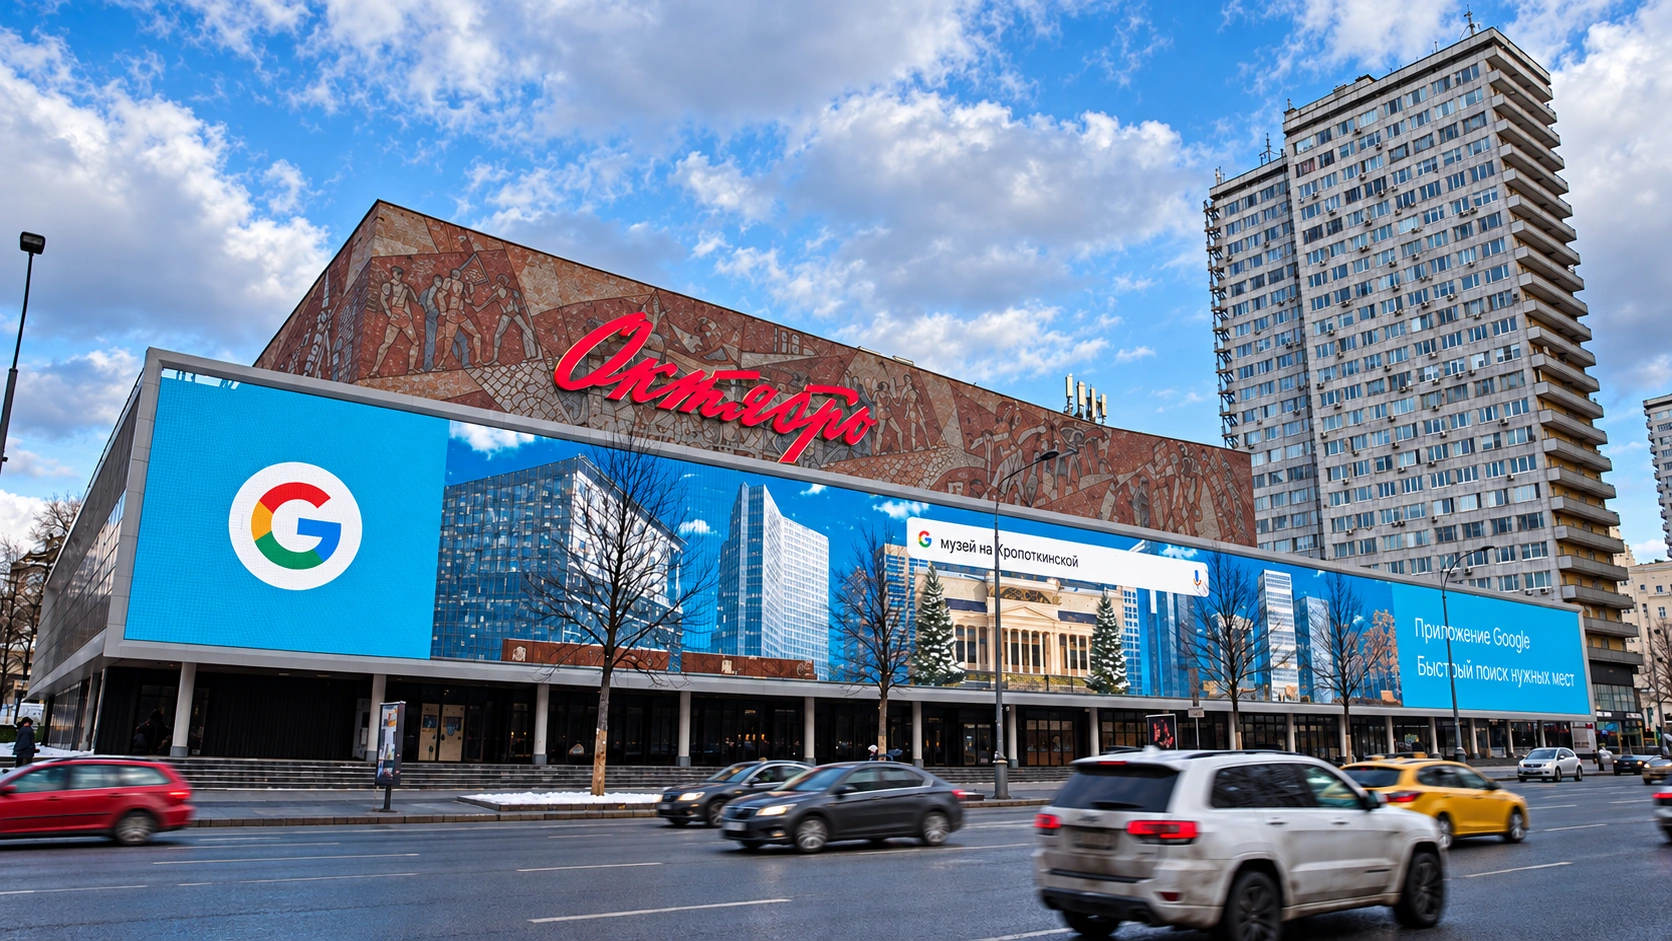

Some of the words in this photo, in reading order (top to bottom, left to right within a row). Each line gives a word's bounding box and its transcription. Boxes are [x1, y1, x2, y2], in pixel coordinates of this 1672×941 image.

[251, 482, 342, 570] G
[918, 530, 932, 548] G
[940, 538, 976, 554] музей
[979, 544, 993, 556] на
[1414, 617, 1491, 645] Приложение
[1493, 627, 1531, 654] Google
[1476, 664, 1509, 682] поиск
[1511, 668, 1551, 688] нужных
[1552, 672, 1575, 687] мест
